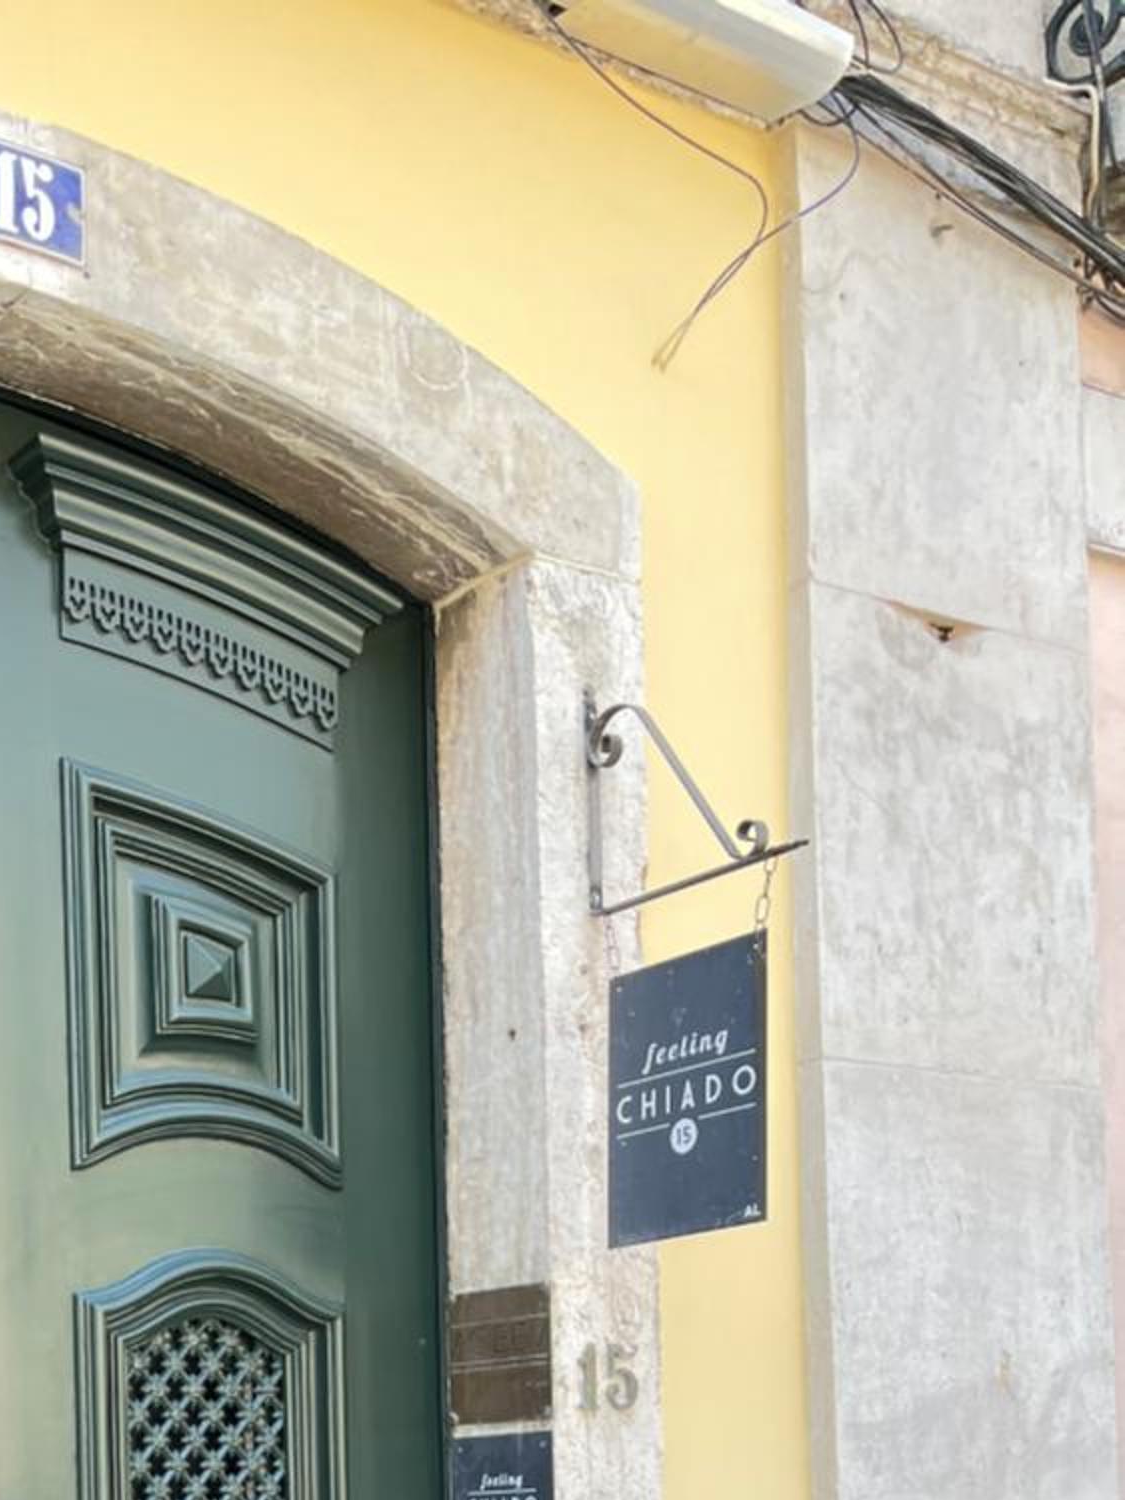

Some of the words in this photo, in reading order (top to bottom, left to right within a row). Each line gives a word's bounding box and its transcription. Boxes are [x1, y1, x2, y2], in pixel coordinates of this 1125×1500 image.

[641, 1029, 728, 1076] feeling
[616, 1064, 757, 1124] CHIADO
[675, 1125, 693, 1147] 15
[576, 1341, 639, 1411] 15
